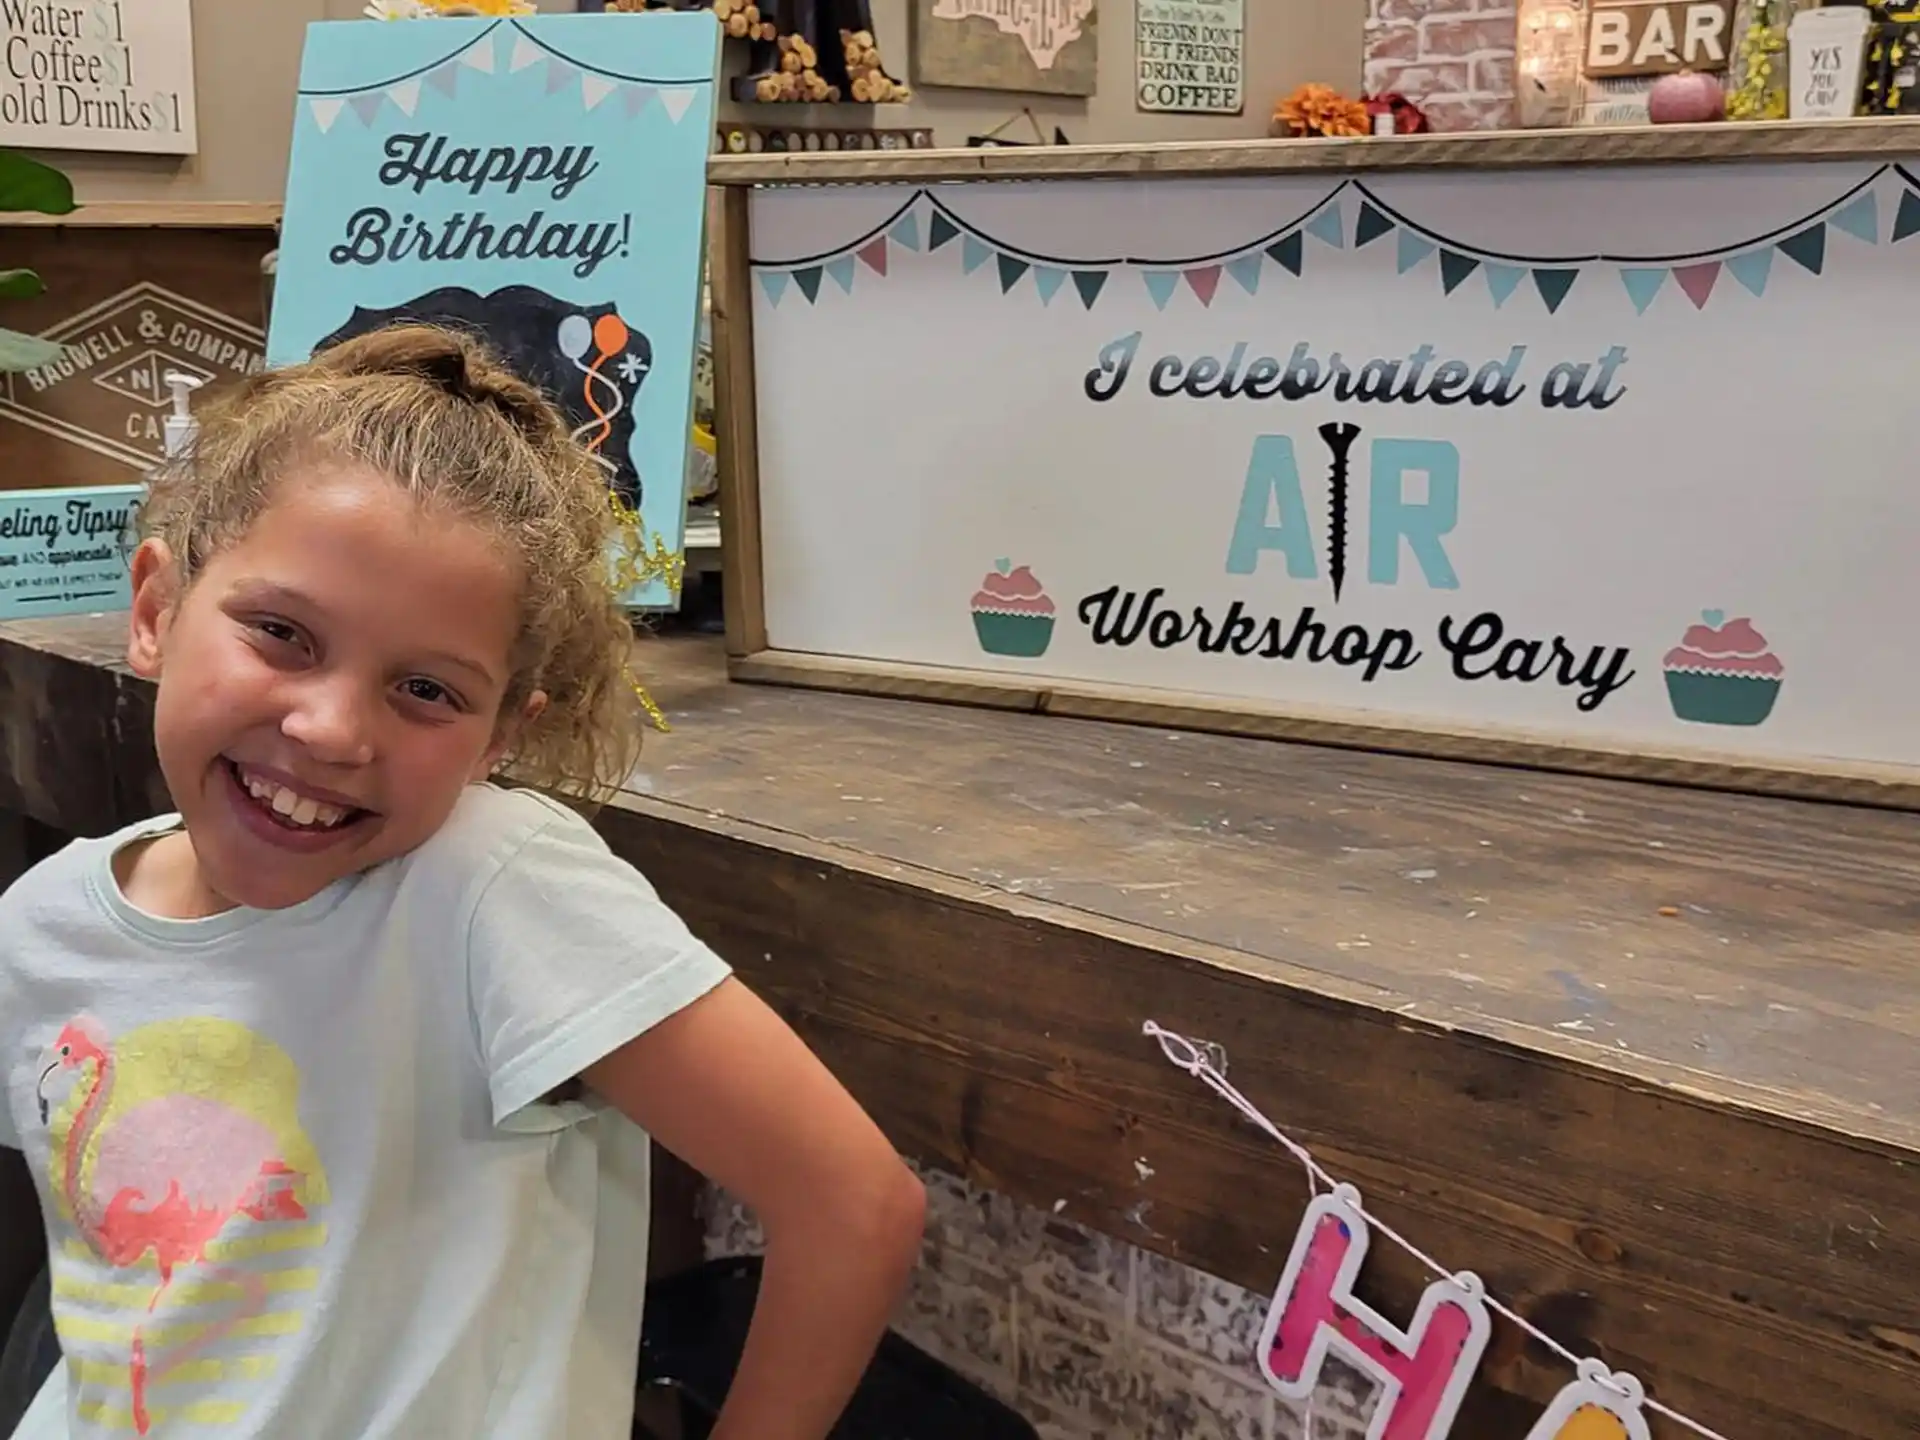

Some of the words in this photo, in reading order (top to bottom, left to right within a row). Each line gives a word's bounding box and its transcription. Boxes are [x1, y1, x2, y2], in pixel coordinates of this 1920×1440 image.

[2, 0, 83, 38] Water
[1139, 22, 1197, 41] FRIENDS
[1202, 26, 1242, 46] DON'T
[1588, 4, 1727, 67] BAR
[1139, 40, 1171, 60] LET
[1175, 42, 1239, 65] FRIENDS
[1809, 46, 1842, 70] YES
[1140, 61, 1199, 82] DRINK
[1206, 65, 1239, 84] BAD
[1140, 83, 1237, 109] COFFEE
[379, 132, 599, 200] Happy
[330, 207, 632, 278] Birthday!
[25, 325, 134, 393] BAGWELL
[138, 310, 165, 344] &
[169, 322, 266, 377] COMPAN
[1084, 331, 1142, 401] I
[1149, 342, 1527, 408] celebrated
[1540, 345, 1628, 409] at
[126, 413, 167, 439] CA
[1078, 585, 1421, 682] Workshop
[1437, 612, 1636, 712] Cary
